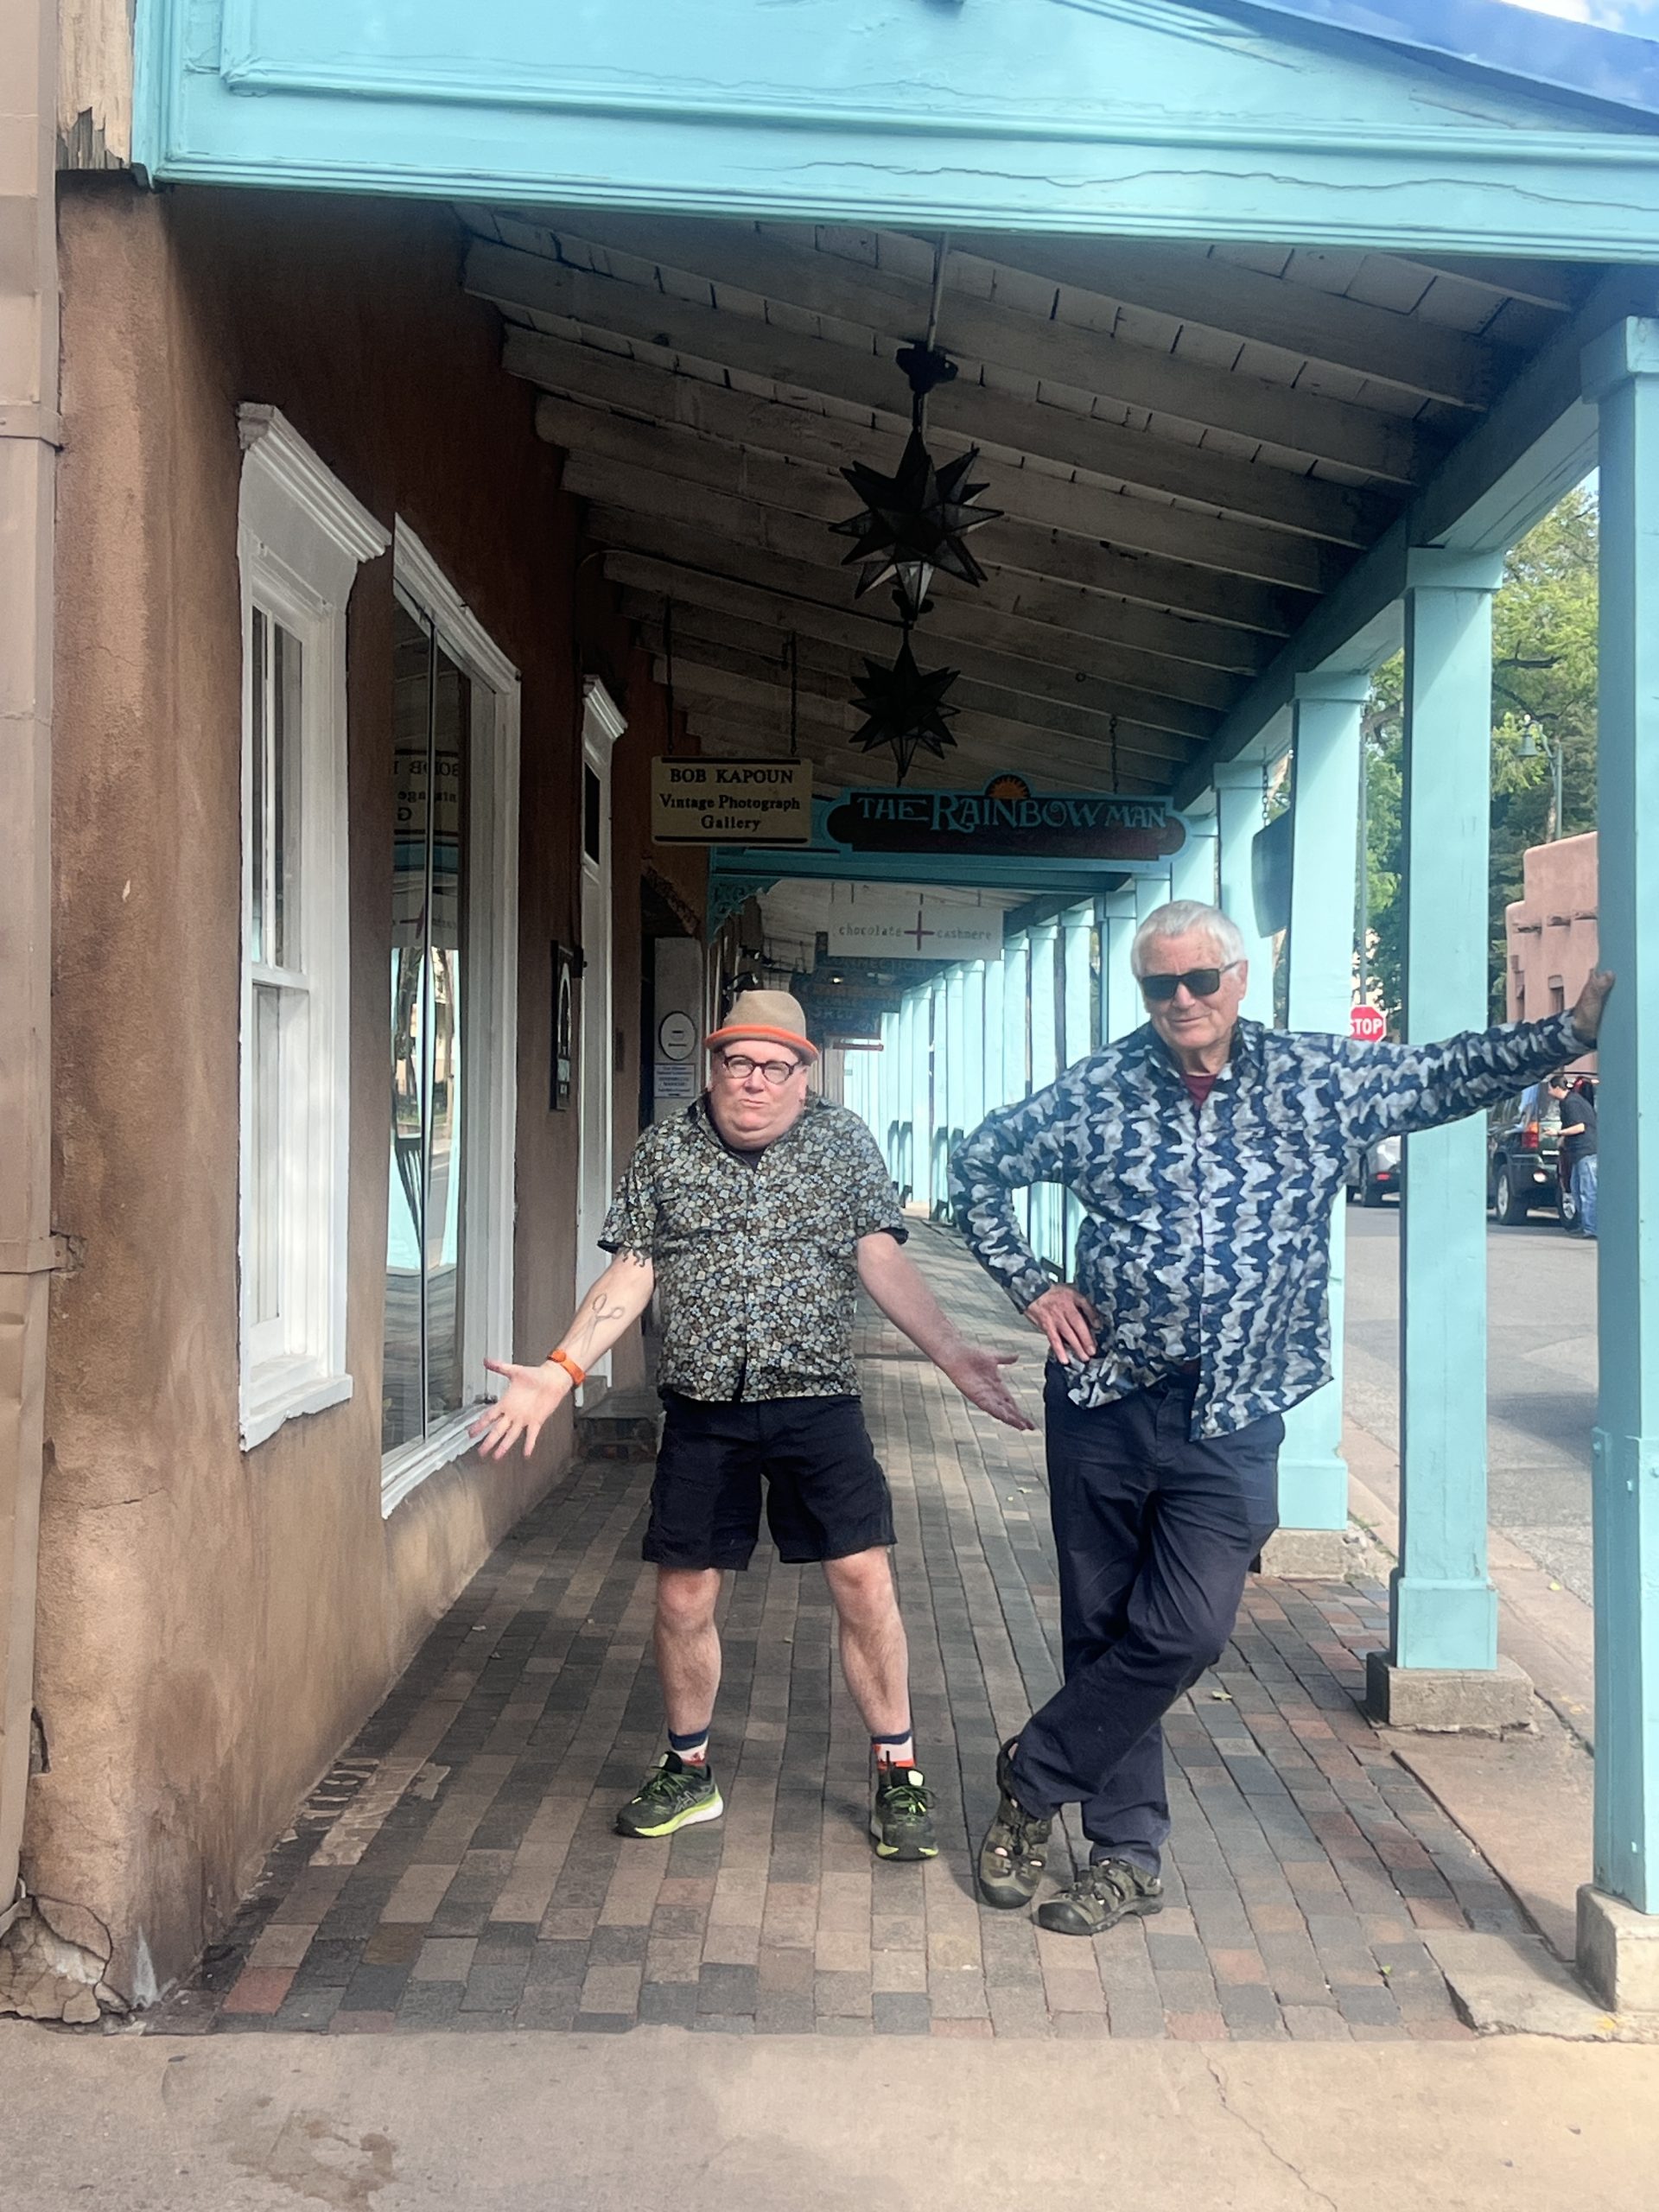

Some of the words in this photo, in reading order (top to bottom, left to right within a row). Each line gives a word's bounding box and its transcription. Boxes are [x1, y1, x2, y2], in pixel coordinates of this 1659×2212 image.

[670, 768, 707, 783] BOB
[715, 768, 793, 784] KAPOUN
[659, 793, 715, 810] Vintage
[718, 794, 800, 812] Photograph
[701, 815, 760, 832] Gallery
[856, 797, 930, 821] THE
[930, 794, 1105, 834] RAINBOW
[1104, 804, 1166, 829] MAN
[839, 922, 902, 938] chocolate
[936, 926, 992, 941] cashmere
